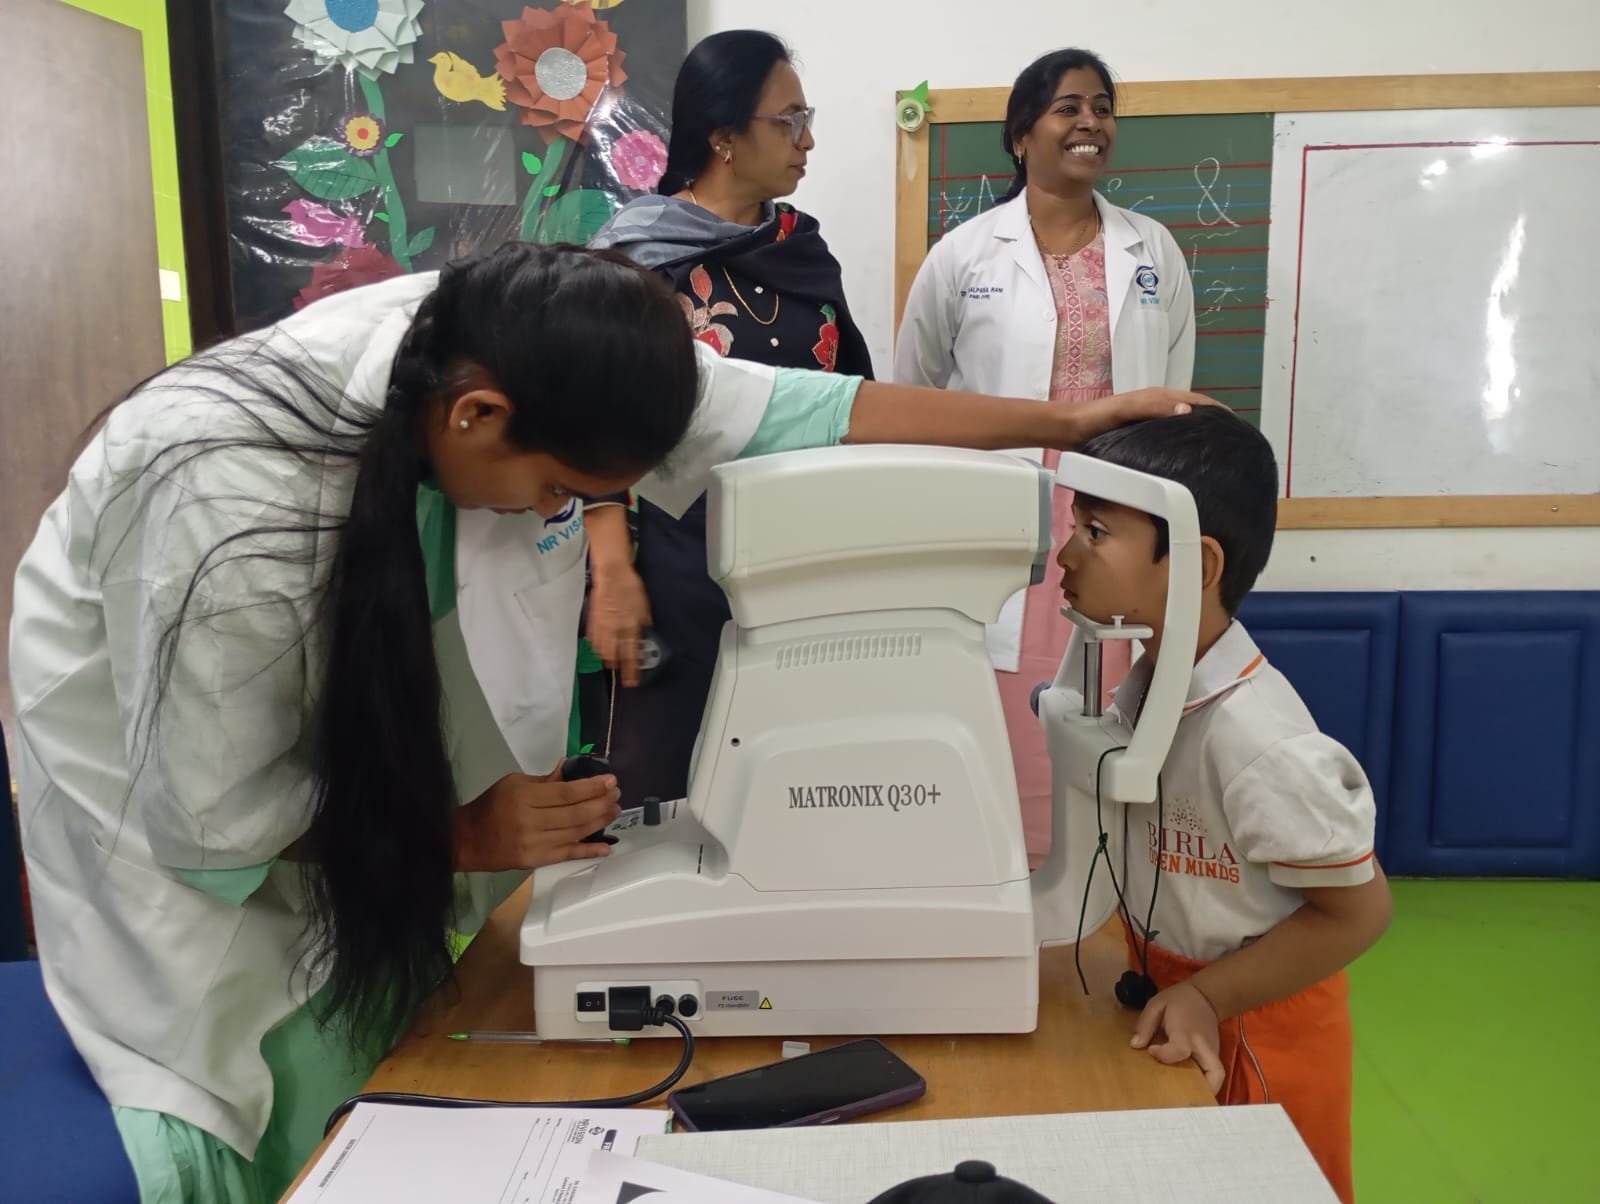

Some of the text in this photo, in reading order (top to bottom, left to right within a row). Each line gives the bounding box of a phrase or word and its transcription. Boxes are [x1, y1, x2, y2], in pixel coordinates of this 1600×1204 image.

[536, 535, 559, 555] NR
[788, 783, 941, 812] MATRONIX Q30+
[1146, 820, 1240, 865] BIRLA
[1185, 857, 1240, 884] MINDS
